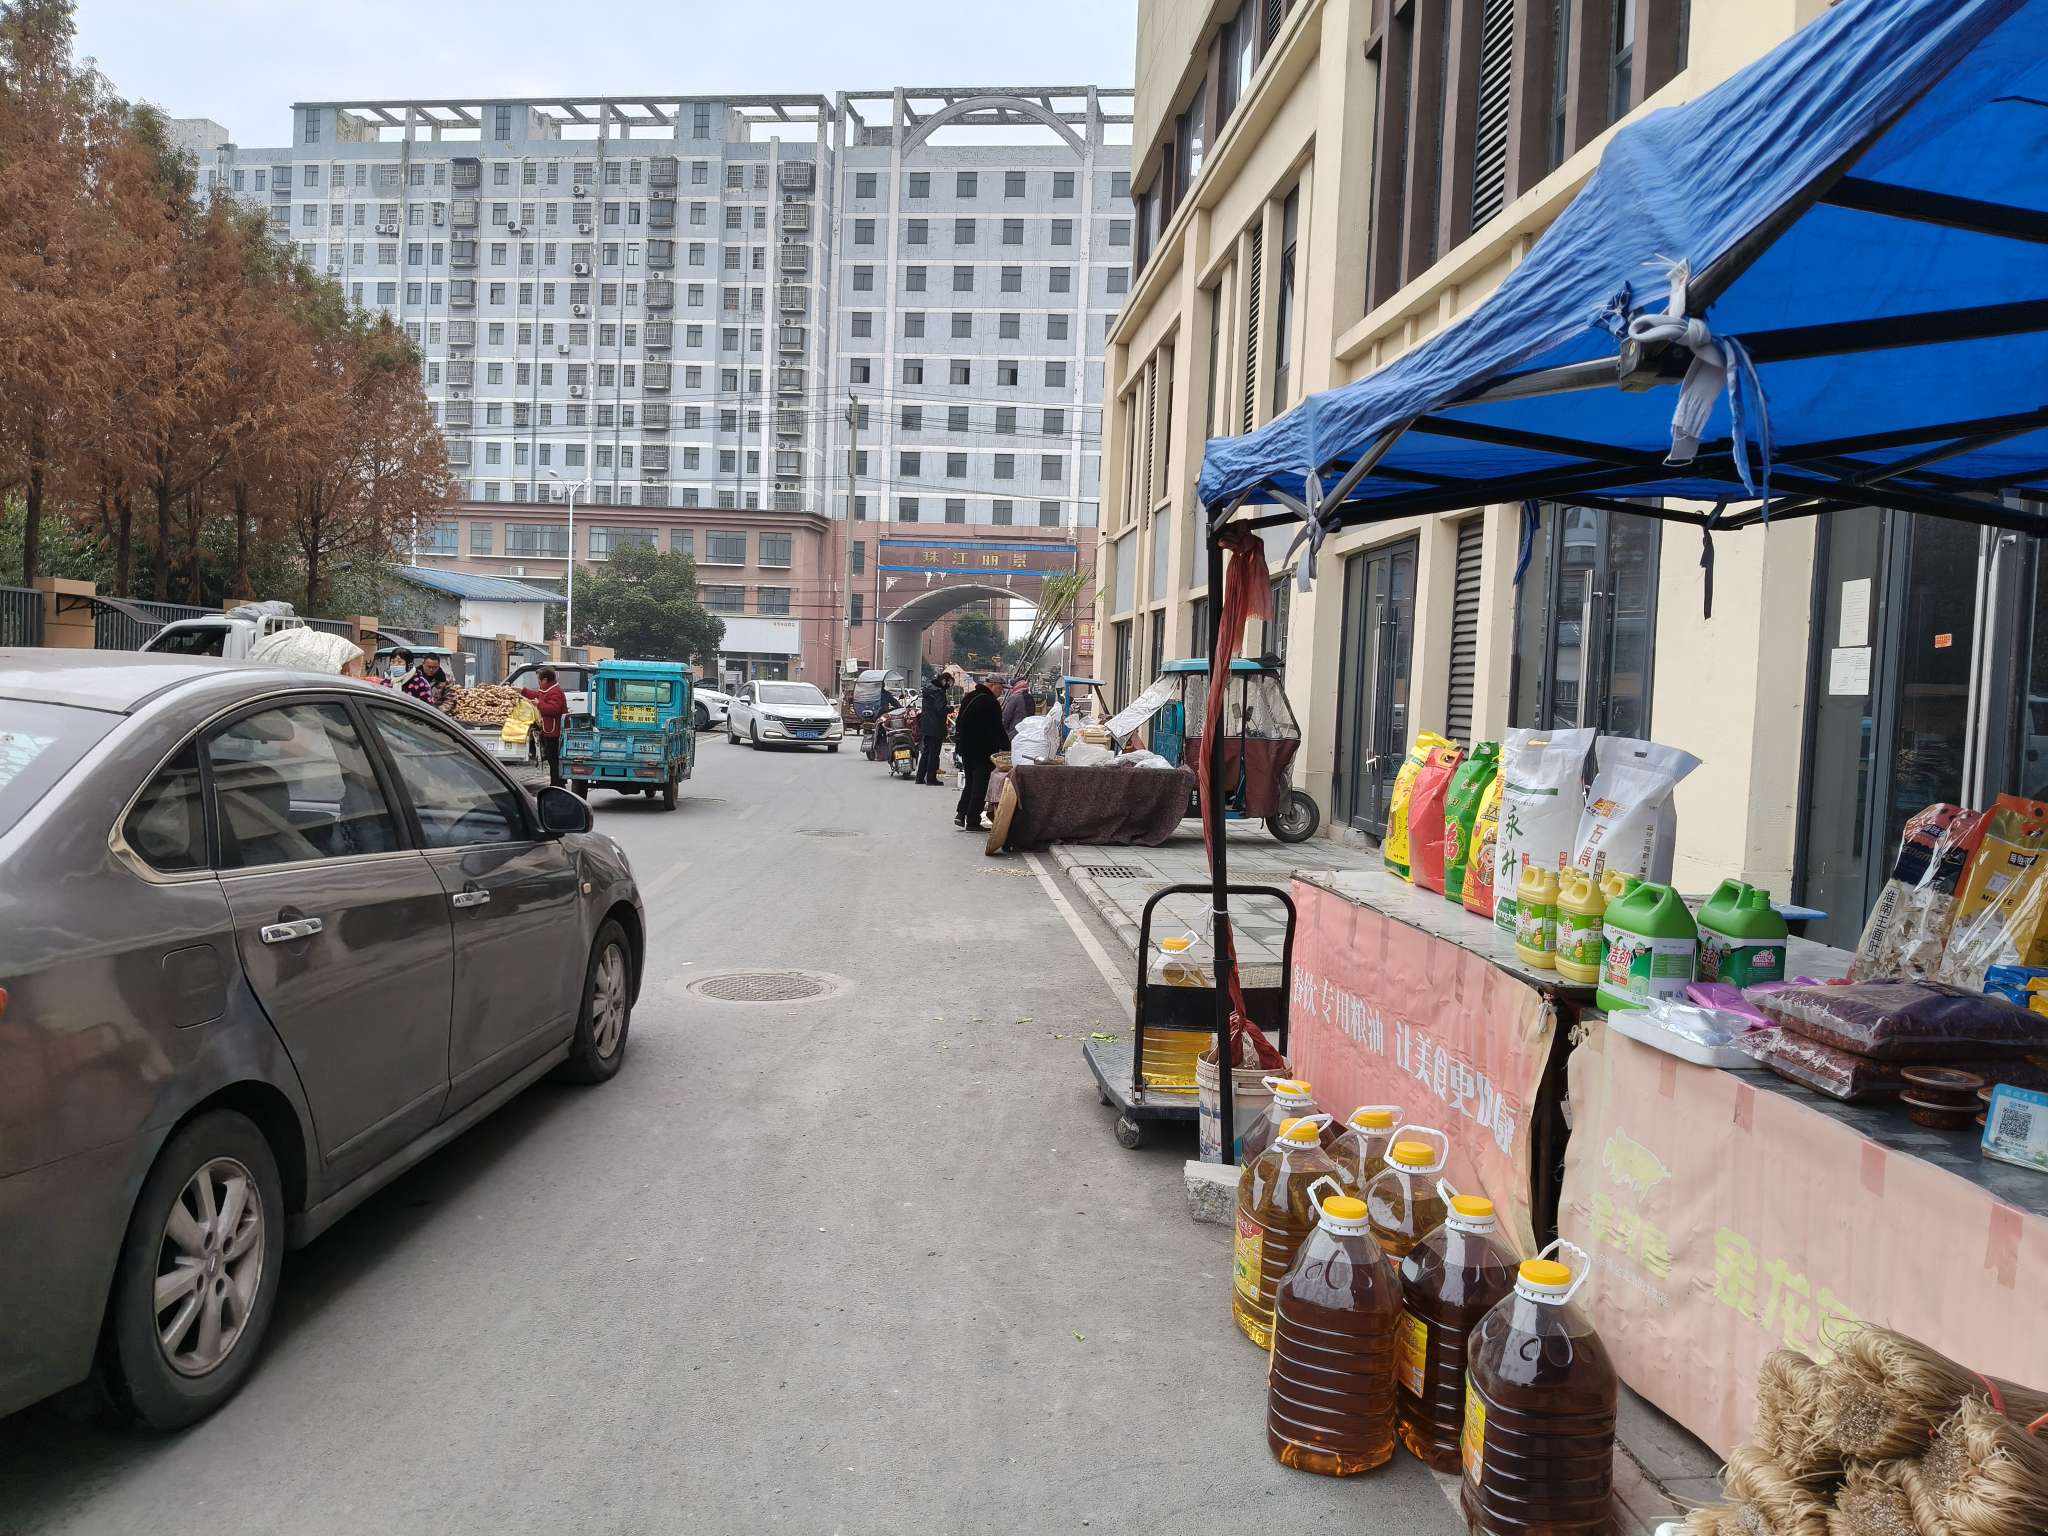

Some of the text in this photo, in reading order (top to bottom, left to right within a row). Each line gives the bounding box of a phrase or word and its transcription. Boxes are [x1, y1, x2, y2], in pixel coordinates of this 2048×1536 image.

[922, 551, 1027, 568] 珠江丽景
[1981, 893, 2015, 907] MIYE
[1868, 887, 1897, 953] 淮南王面叶
